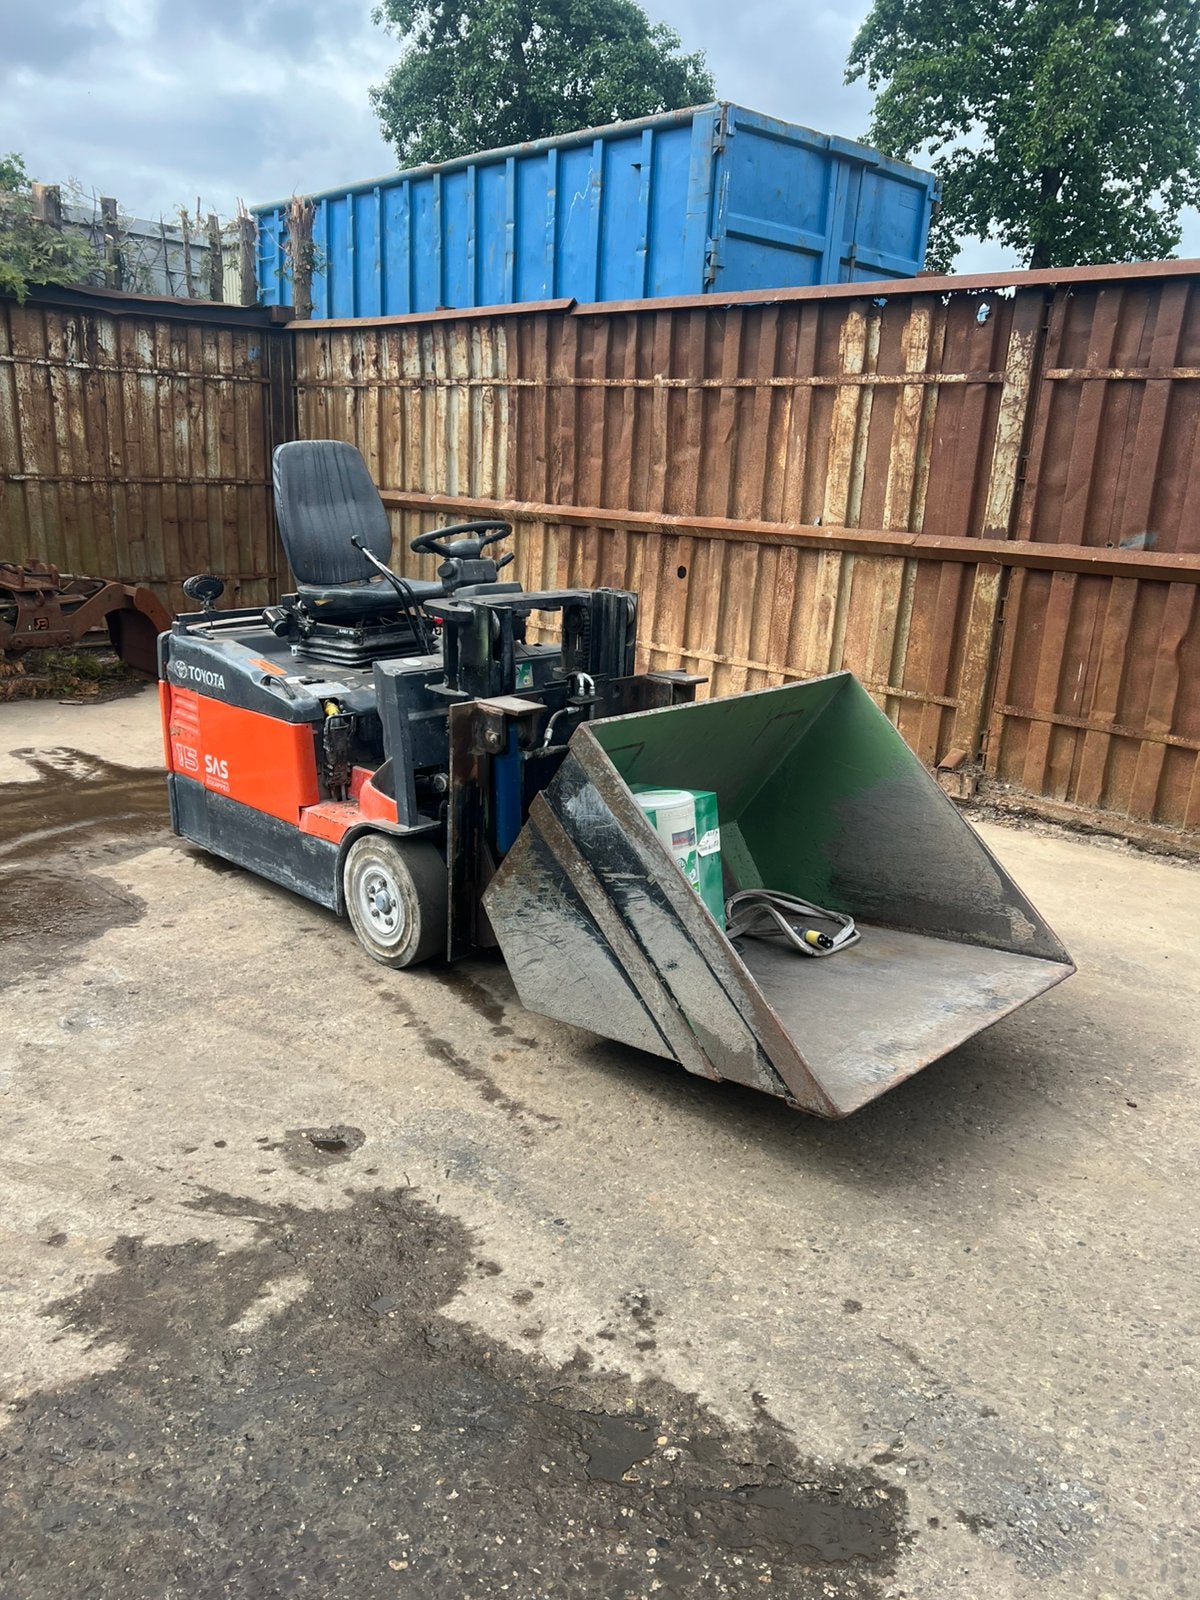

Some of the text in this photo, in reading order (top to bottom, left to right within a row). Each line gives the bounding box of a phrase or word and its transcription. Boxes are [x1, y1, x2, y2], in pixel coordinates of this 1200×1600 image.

[188, 665, 225, 690] TOYOTA
[176, 743, 199, 771] 15
[205, 754, 229, 779] SAS
